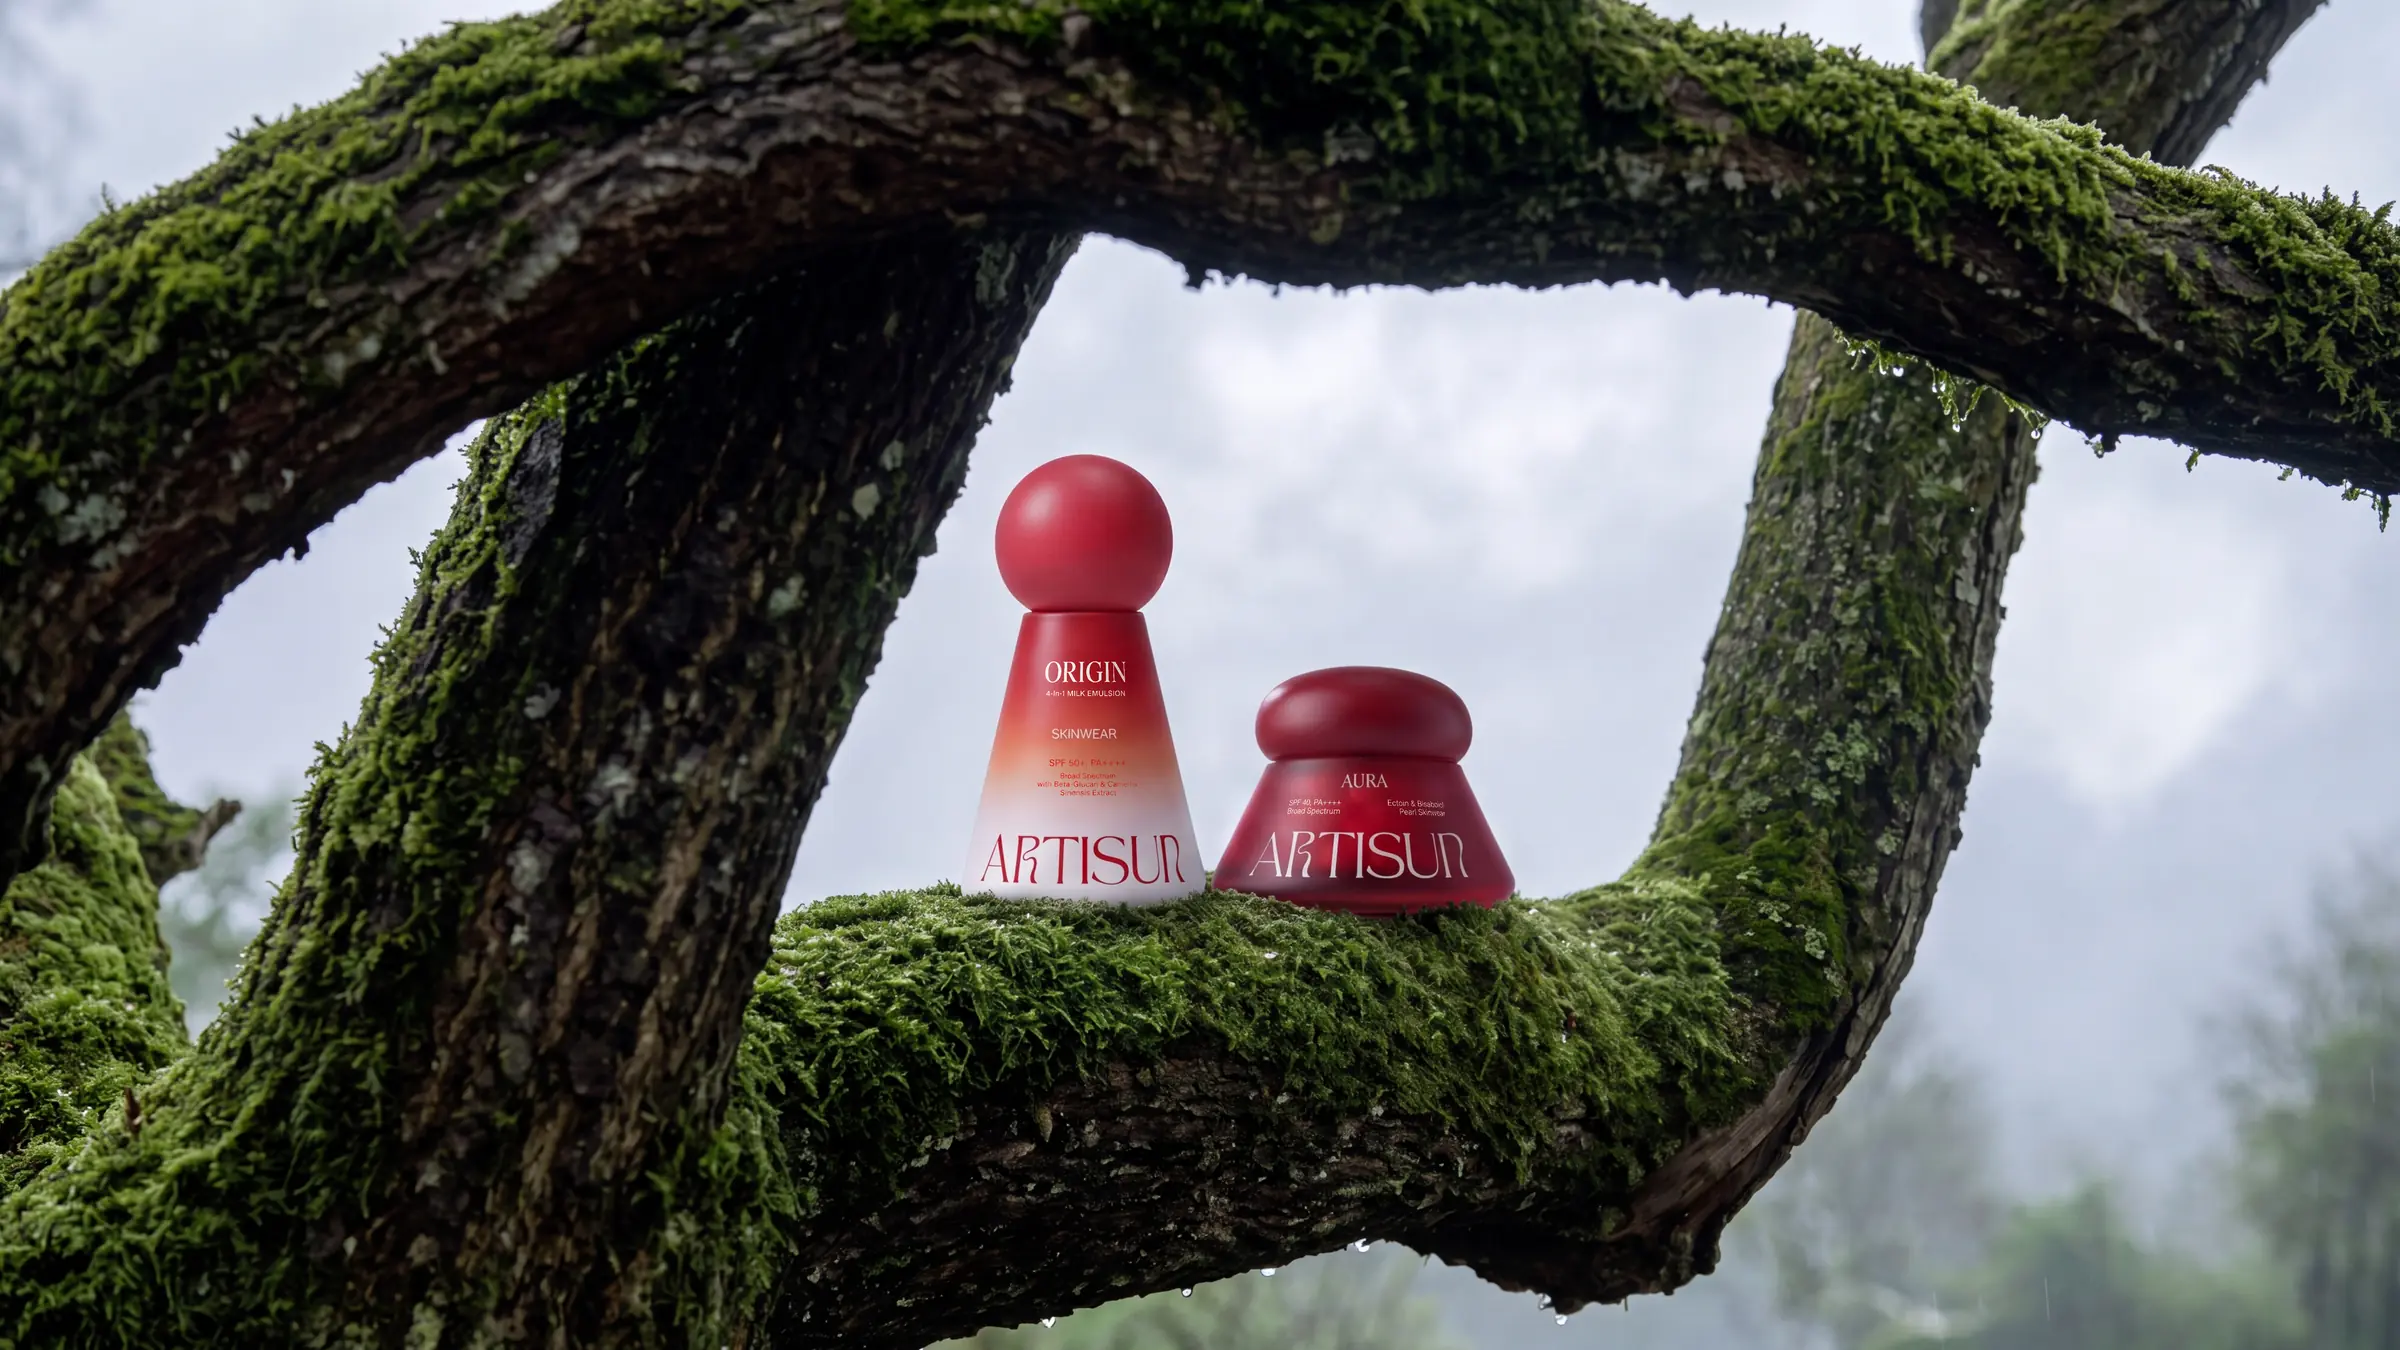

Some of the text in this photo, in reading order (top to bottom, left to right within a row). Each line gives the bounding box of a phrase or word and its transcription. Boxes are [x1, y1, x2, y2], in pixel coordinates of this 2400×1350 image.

[1044, 660, 1126, 683] ORIGIN
[1051, 728, 1117, 739] SKINWEAR
[1049, 759, 1065, 767] SPF
[1082, 772, 1116, 780] Spectrum
[1037, 780, 1052, 788] with
[1100, 780, 1106, 788] &
[1341, 773, 1388, 788] AURA
[1288, 798, 1301, 806] SPF
[1411, 799, 1416, 807] &
[1287, 807, 1341, 816] Broad Spectrum
[1399, 808, 1417, 816] Pearl
[980, 833, 1186, 885] ARTISUN
[1249, 832, 1469, 879] ARTISUN
